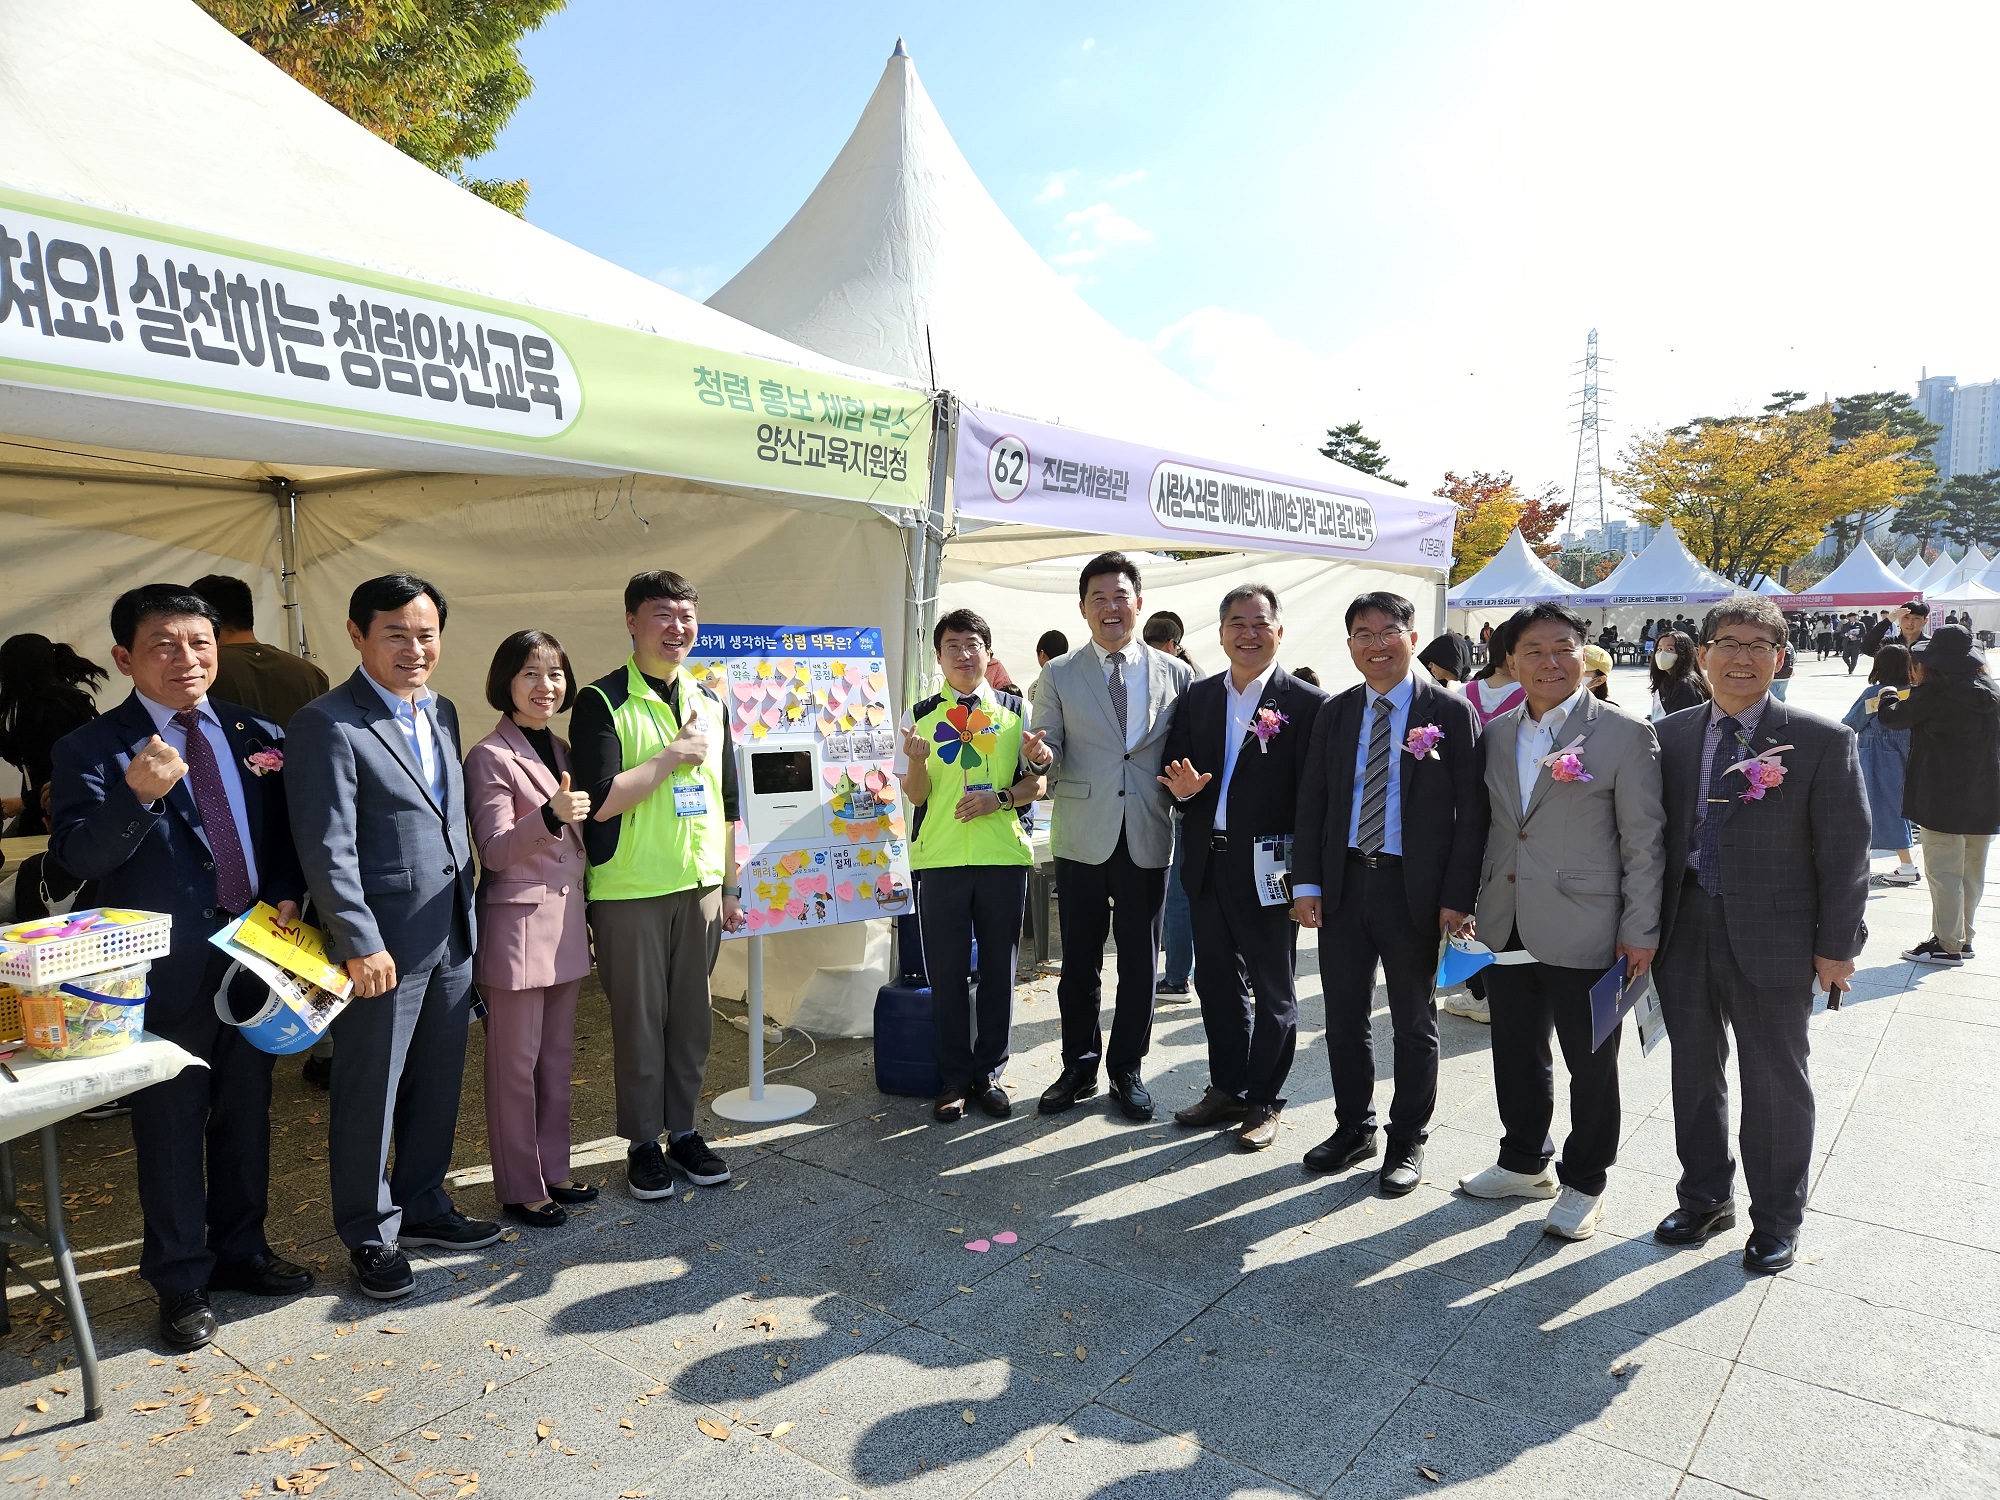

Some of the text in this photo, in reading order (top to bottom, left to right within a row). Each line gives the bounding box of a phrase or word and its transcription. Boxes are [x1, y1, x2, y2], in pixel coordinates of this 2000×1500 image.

[129, 254, 330, 381] 실천하는
[330, 293, 563, 420] 청렴양산교육
[693, 365, 910, 441] 청렴 홍보 체험 부스
[756, 423, 908, 482] 양산교육지원청
[994, 448, 1024, 487] 62
[1041, 456, 1130, 503] 진로체험관
[1156, 471, 1220, 523] 사랑스러운
[1317, 500, 1338, 538] 고리
[1337, 503, 1356, 540] 걸고
[1355, 506, 1374, 543] 반짝
[729, 634, 778, 650] 생각하는
[781, 633, 807, 650] 청렴
[811, 633, 852, 650] 덕목은?
[741, 661, 748, 670] 2
[822, 661, 828, 669] 3
[732, 670, 751, 681] 약속
[813, 670, 831, 681] 공정
[843, 849, 849, 858] 6
[762, 857, 768, 866] 5
[835, 858, 852, 870] 절제
[752, 867, 771, 878] 배려
